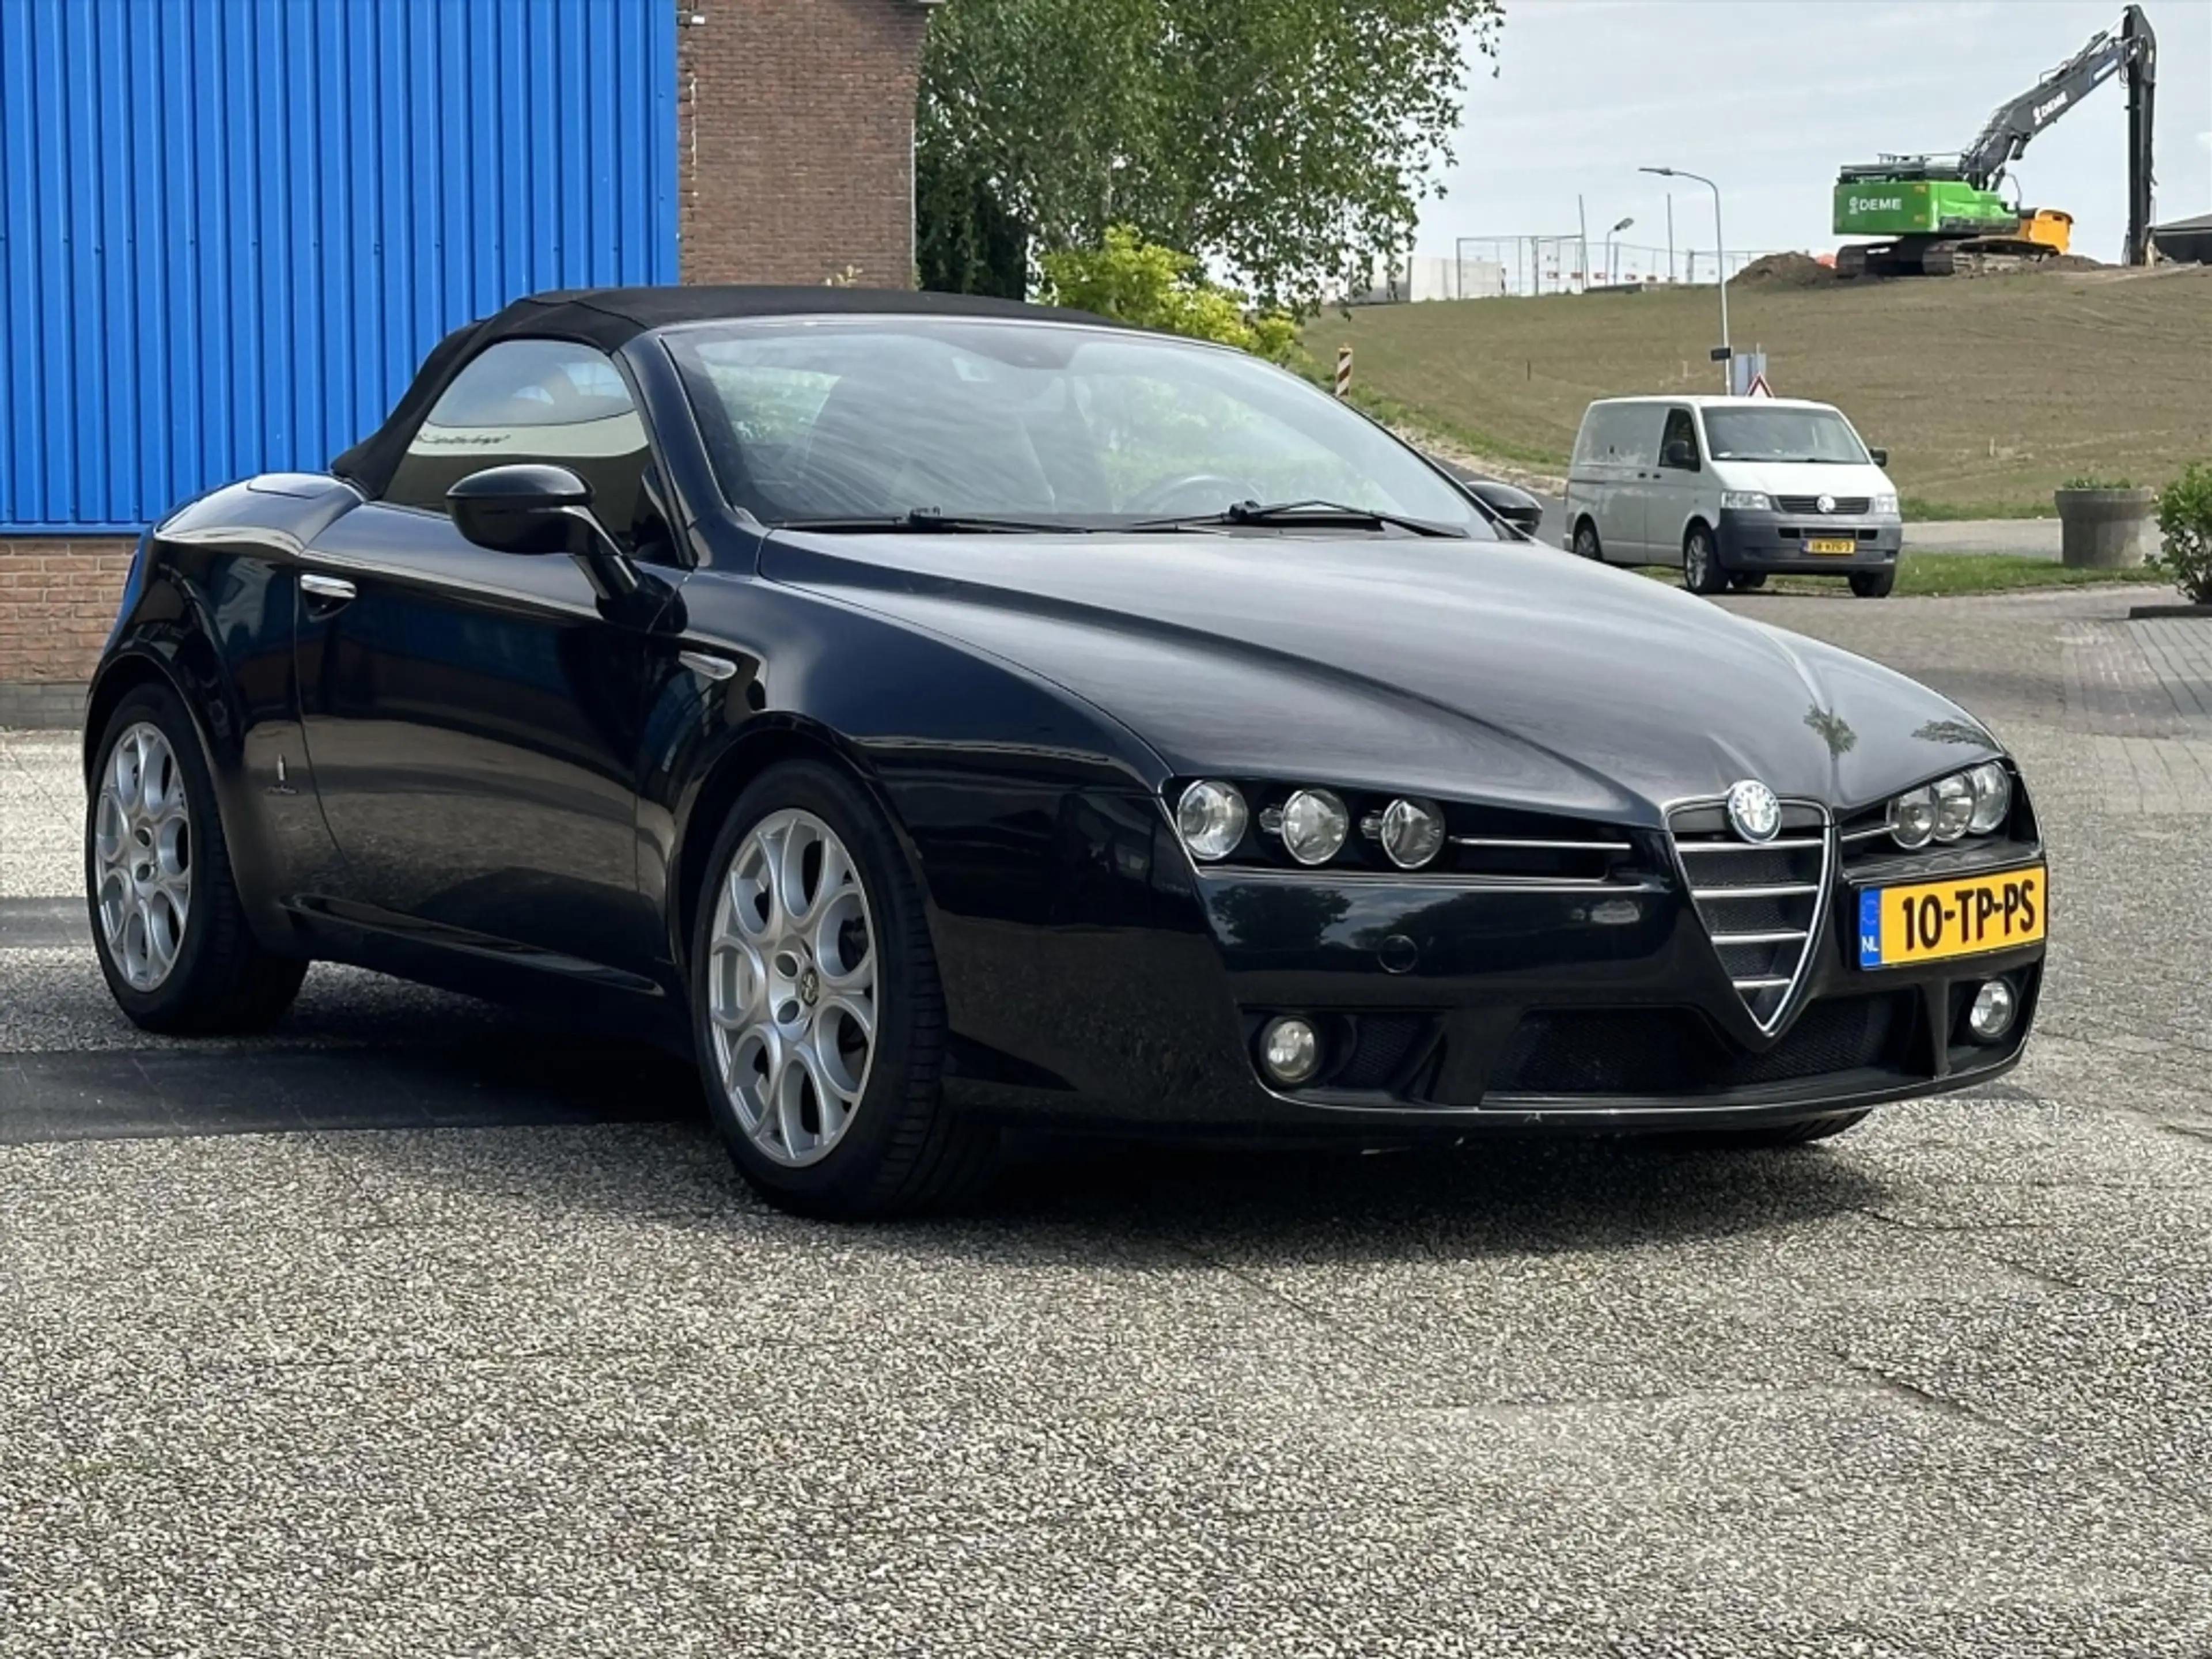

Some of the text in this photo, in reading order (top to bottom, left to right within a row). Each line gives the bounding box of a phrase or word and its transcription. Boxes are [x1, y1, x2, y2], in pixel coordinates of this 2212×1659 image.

[1859, 198, 1902, 211] DEME
[1903, 879, 2035, 951] 10-TP-PS
[1861, 935, 1879, 952] NL
